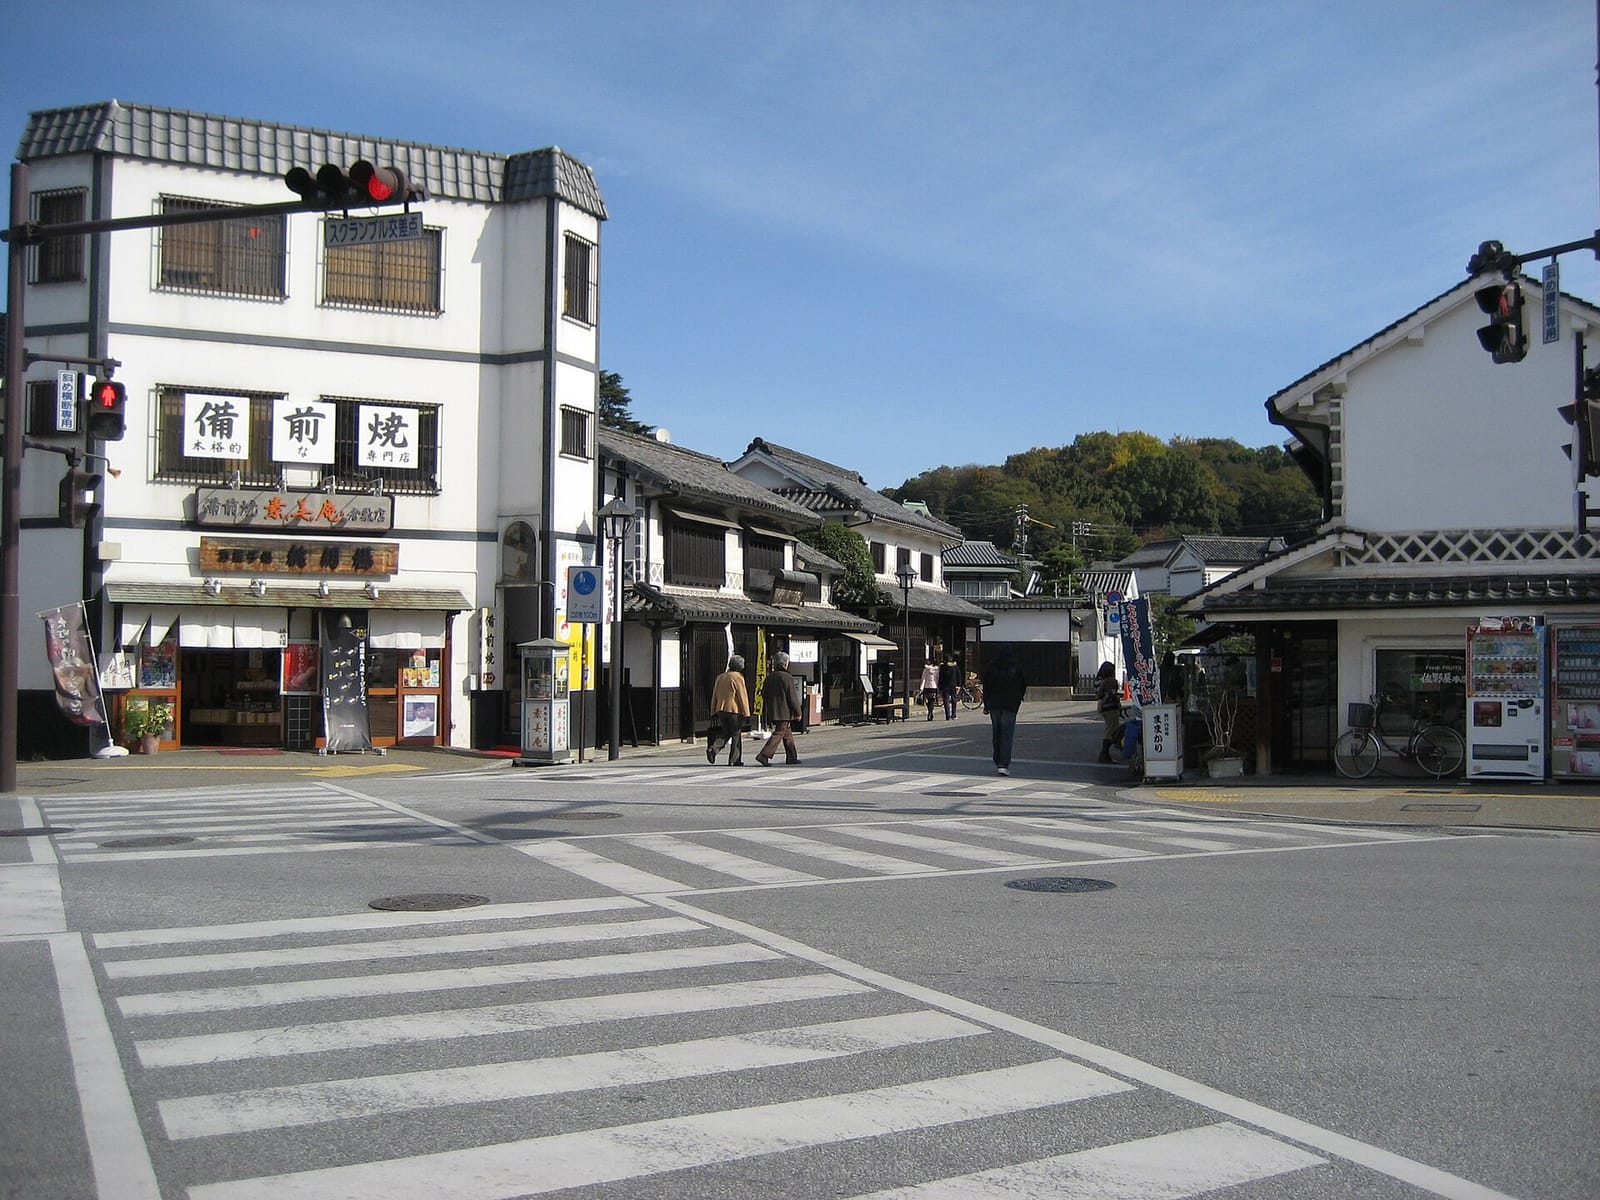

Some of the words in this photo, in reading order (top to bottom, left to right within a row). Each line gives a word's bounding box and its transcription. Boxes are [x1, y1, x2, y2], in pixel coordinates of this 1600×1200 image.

[329, 217, 420, 243] スクランブル交差点
[61, 373, 73, 428] 斜め横断専用
[191, 440, 242, 454] 本格的
[297, 446, 308, 458] な
[366, 449, 411, 463] 専門店
[484, 614, 496, 665] 備前焼
[1153, 714, 1163, 753] ままかり
